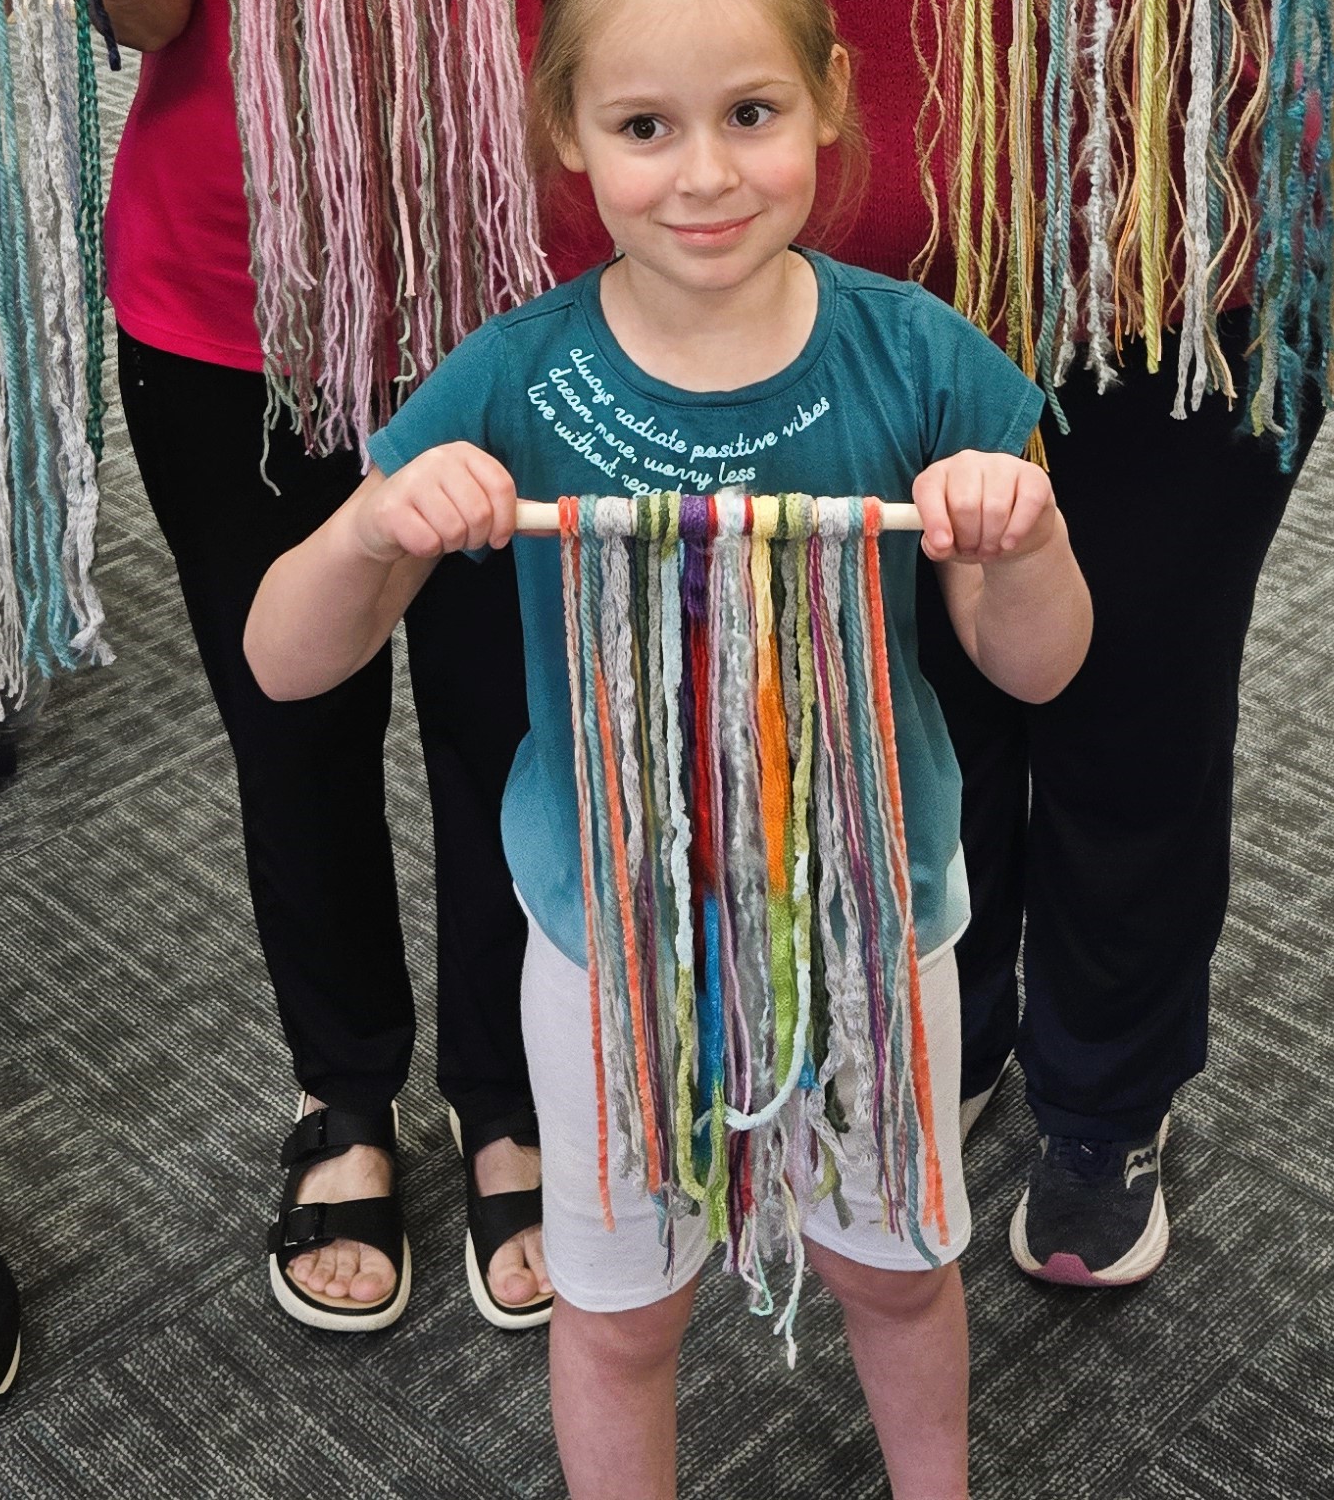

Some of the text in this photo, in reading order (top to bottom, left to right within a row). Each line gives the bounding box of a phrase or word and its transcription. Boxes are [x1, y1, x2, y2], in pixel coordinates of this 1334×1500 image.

[528, 382, 556, 420] live
[554, 421, 620, 478] without
[549, 368, 756, 491] dream more, worry less
[570, 349, 830, 463] always radiate positive vibes
